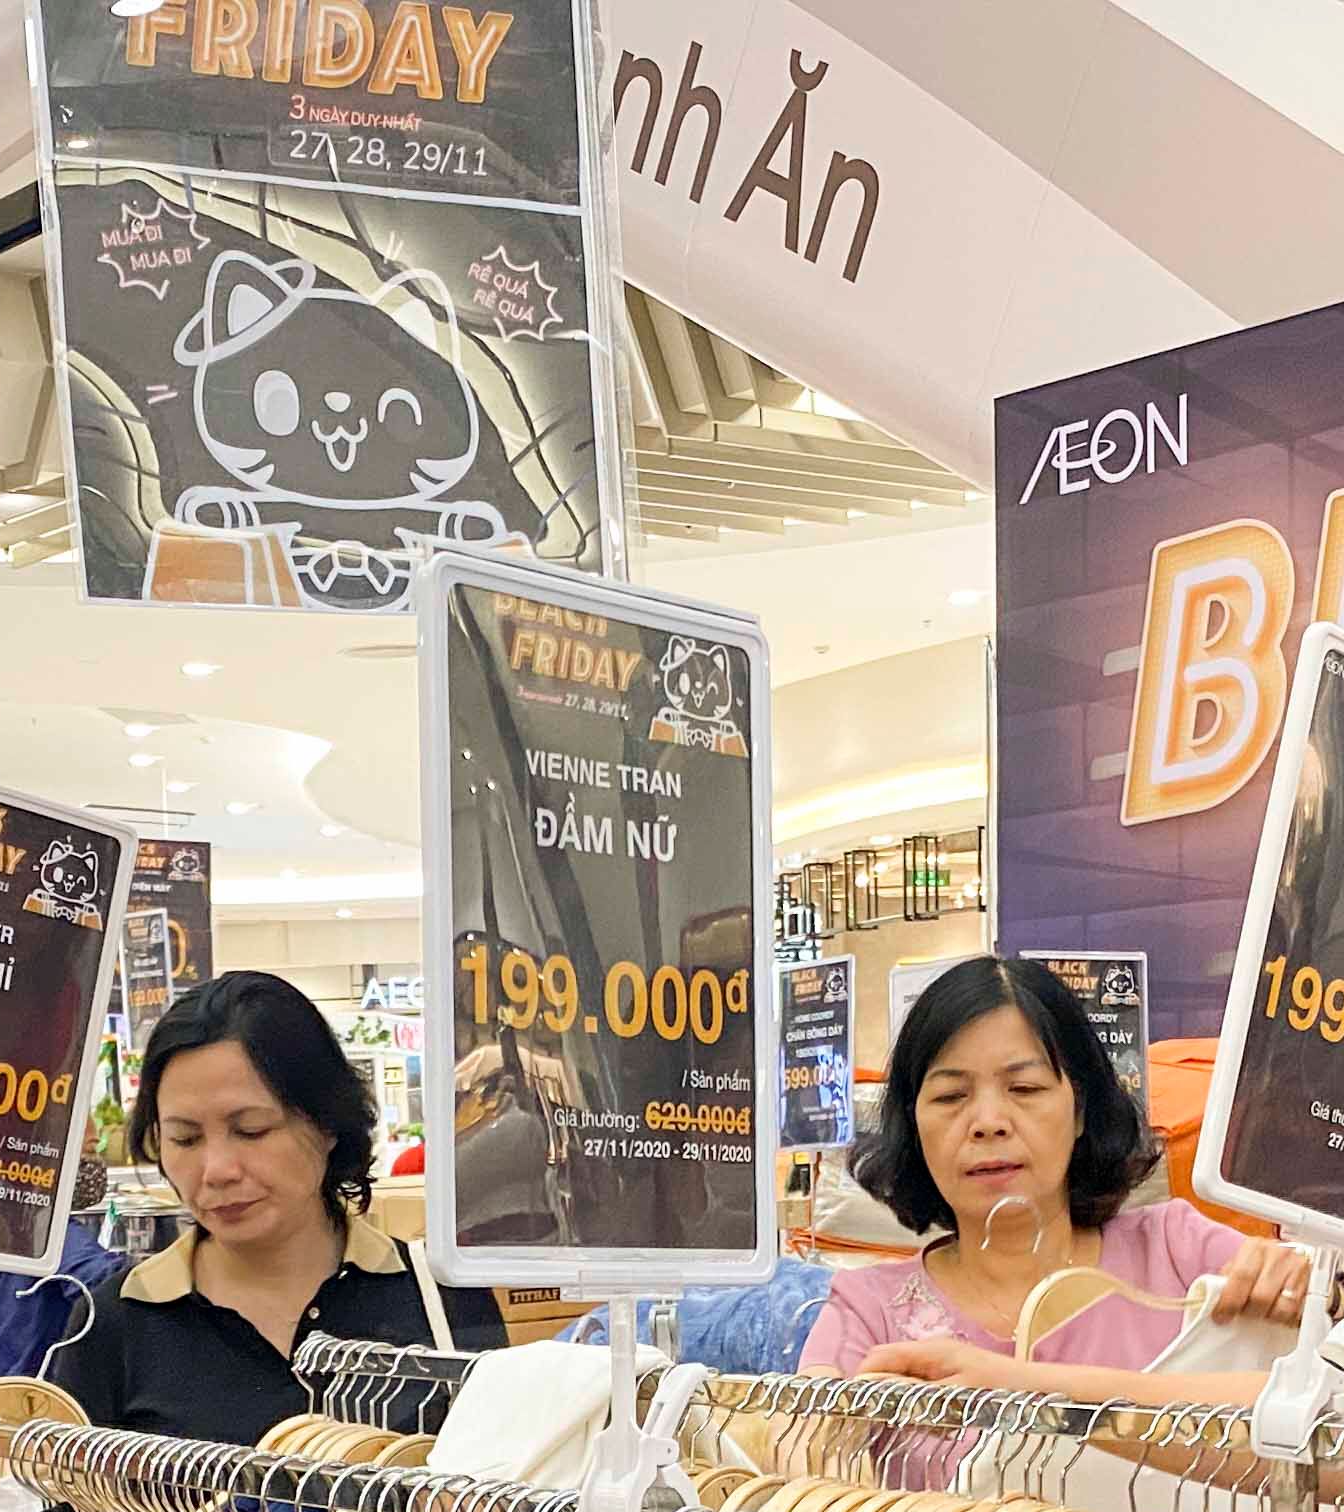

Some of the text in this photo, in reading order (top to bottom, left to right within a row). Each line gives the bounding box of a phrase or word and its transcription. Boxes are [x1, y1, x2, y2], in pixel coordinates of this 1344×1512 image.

[288, 95, 305, 120] 3
[309, 105, 349, 125] NGÀY
[350, 112, 382, 129] DUY
[289, 130, 332, 160] 27
[403, 142, 489, 177] 29/11
[724, 48, 881, 284] Ăn
[129, 250, 171, 271] MUA
[493, 274, 529, 299] QUÁ
[498, 300, 534, 325] QUÁ
[510, 628, 642, 692] FRIDAY
[526, 748, 683, 799] VIENNE TRAN
[534, 792, 679, 862] ĐẦM NỮ
[554, 1107, 578, 1128] Giá
[1310, 1100, 1330, 1121] Giá
[583, 1138, 672, 1159] 27/11/2020
[682, 1143, 753, 1163] 29/11/2020
